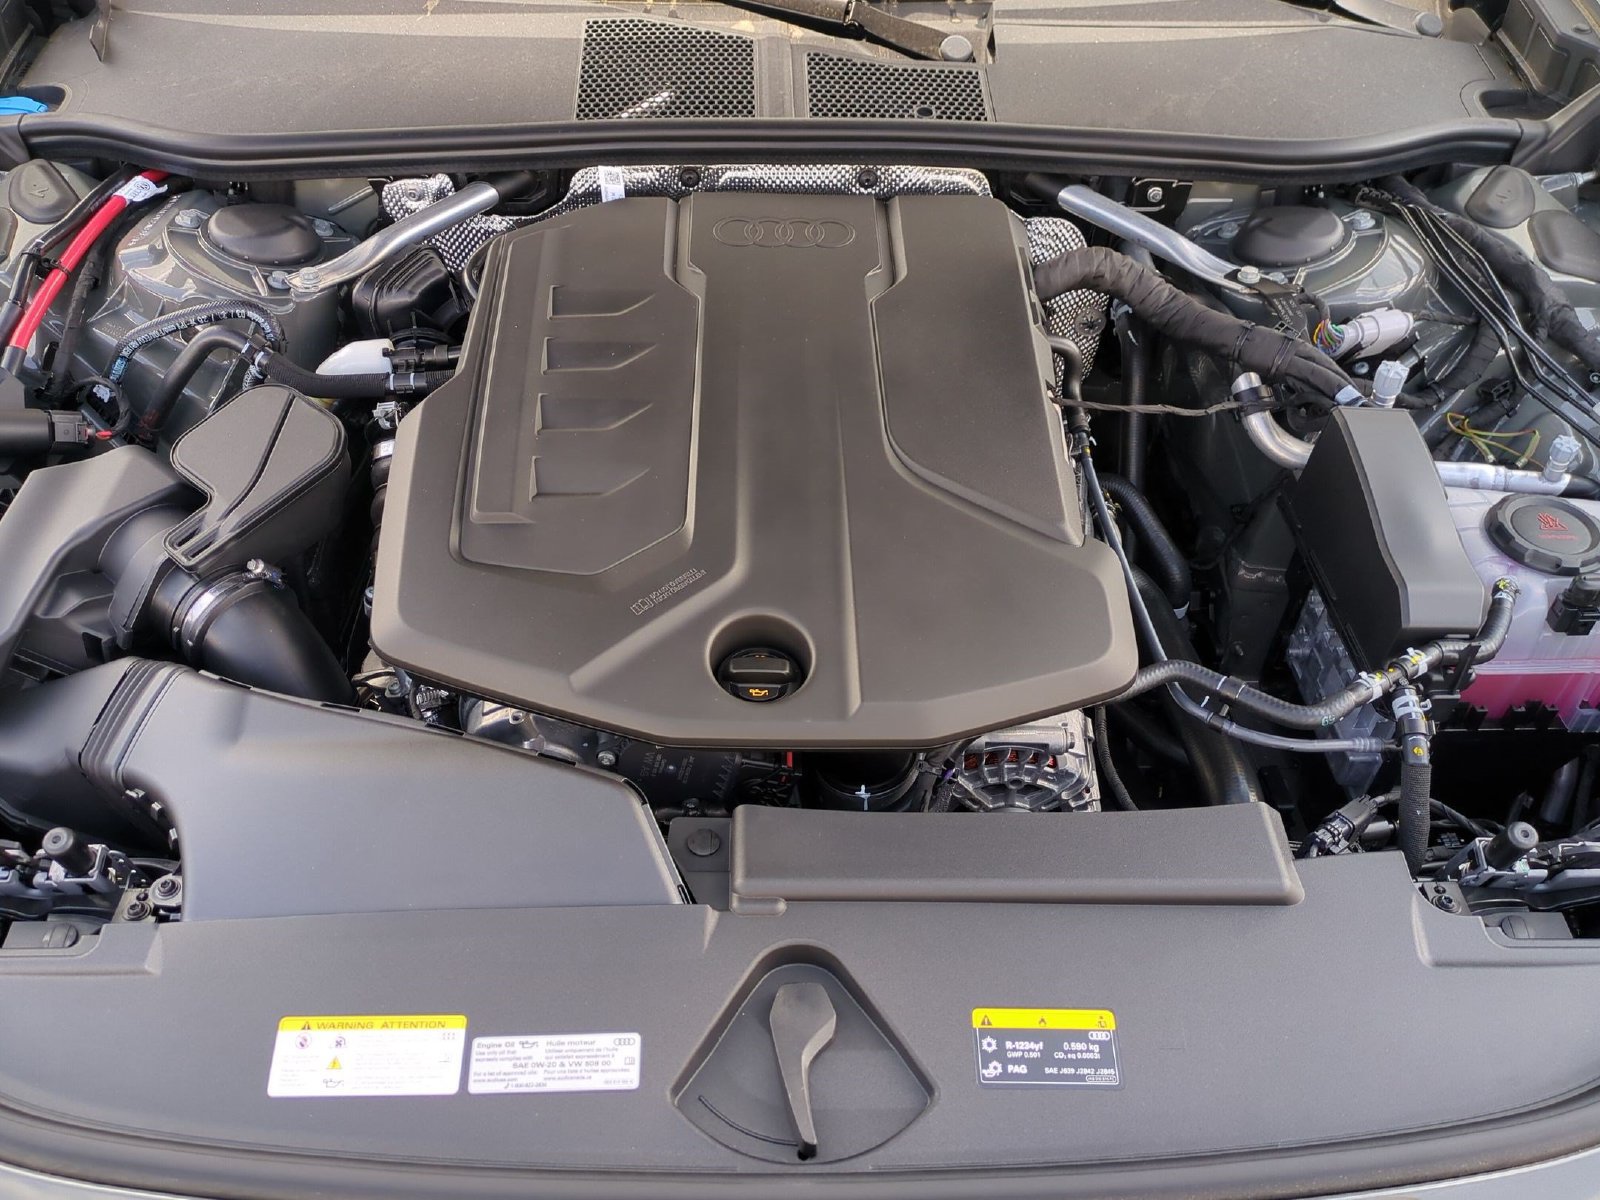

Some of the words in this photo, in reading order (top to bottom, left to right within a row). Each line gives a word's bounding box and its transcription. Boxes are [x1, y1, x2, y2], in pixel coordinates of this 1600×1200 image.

[317, 1021, 374, 1029] WARNING
[380, 1020, 447, 1029] ATTENTION
[1005, 1041, 1044, 1051] R-1234yf
[1063, 1042, 1087, 1051] 0.590
[1089, 1042, 1100, 1052] kg
[1008, 1065, 1027, 1074] PAG
